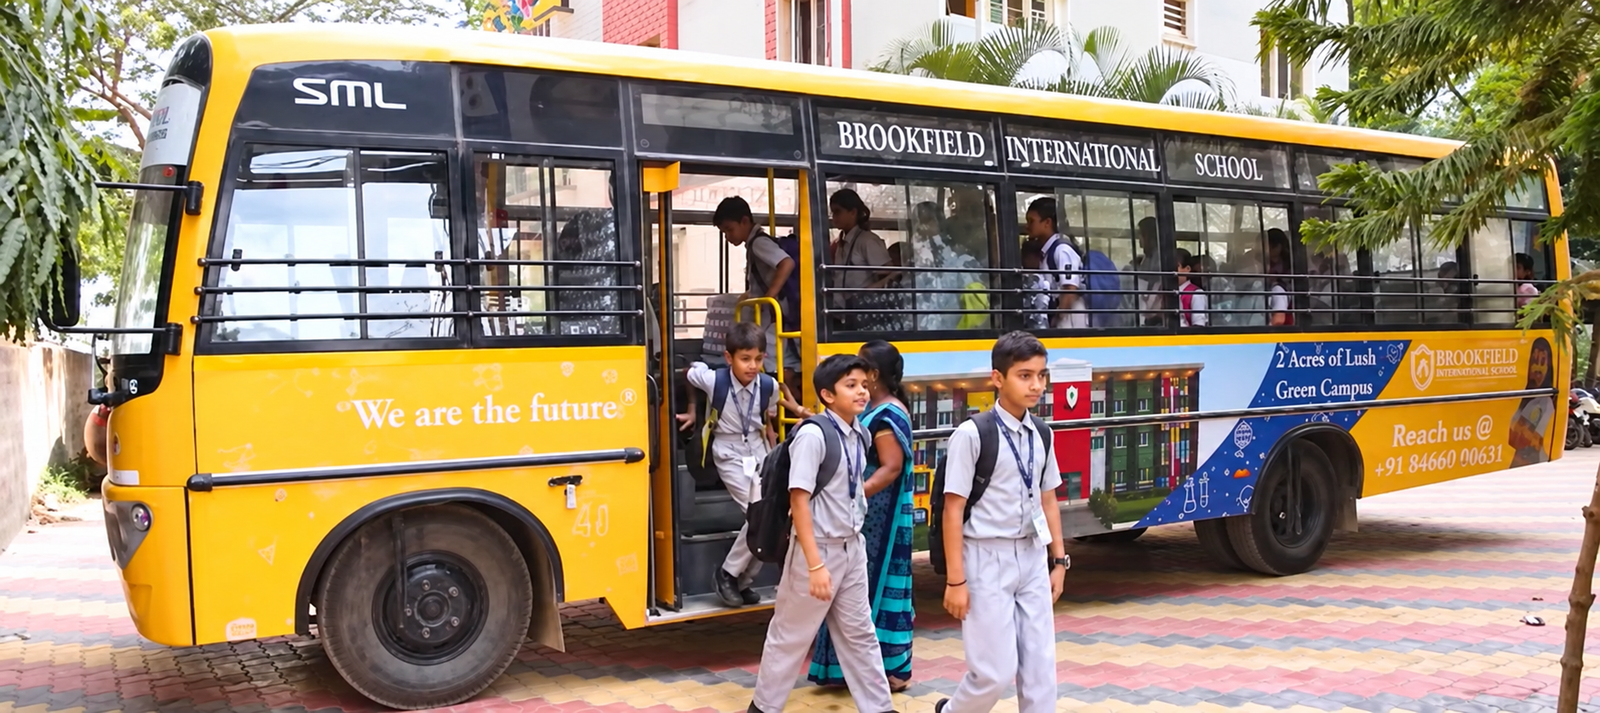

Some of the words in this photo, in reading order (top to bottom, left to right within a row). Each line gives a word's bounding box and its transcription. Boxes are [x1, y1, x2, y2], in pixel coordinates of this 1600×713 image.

[293, 78, 407, 109] SML
[837, 121, 985, 158] BROOKFIELD
[1005, 136, 1161, 172] INTERNATIONAL
[1195, 153, 1263, 181] SCHOOL
[1276, 351, 1285, 368] 2
[1288, 350, 1325, 368] Acres
[1328, 348, 1344, 366] of
[1345, 348, 1376, 366] Lush
[1436, 348, 1518, 366] BROOKFIELD
[1436, 366, 1489, 378] INTERNATIONAL
[1490, 365, 1517, 375] SCHOOL
[1276, 380, 1316, 399] Green
[1320, 378, 1373, 401] Campus
[351, 398, 405, 430] We
[415, 404, 463, 427] are
[472, 394, 521, 425] the
[1392, 420, 1447, 448] Reach
[1453, 425, 1471, 441] us
[1476, 415, 1493, 441] @
[1375, 456, 1403, 477] +91
[1408, 448, 1456, 474] 84660
[1460, 444, 1503, 467] 00631
